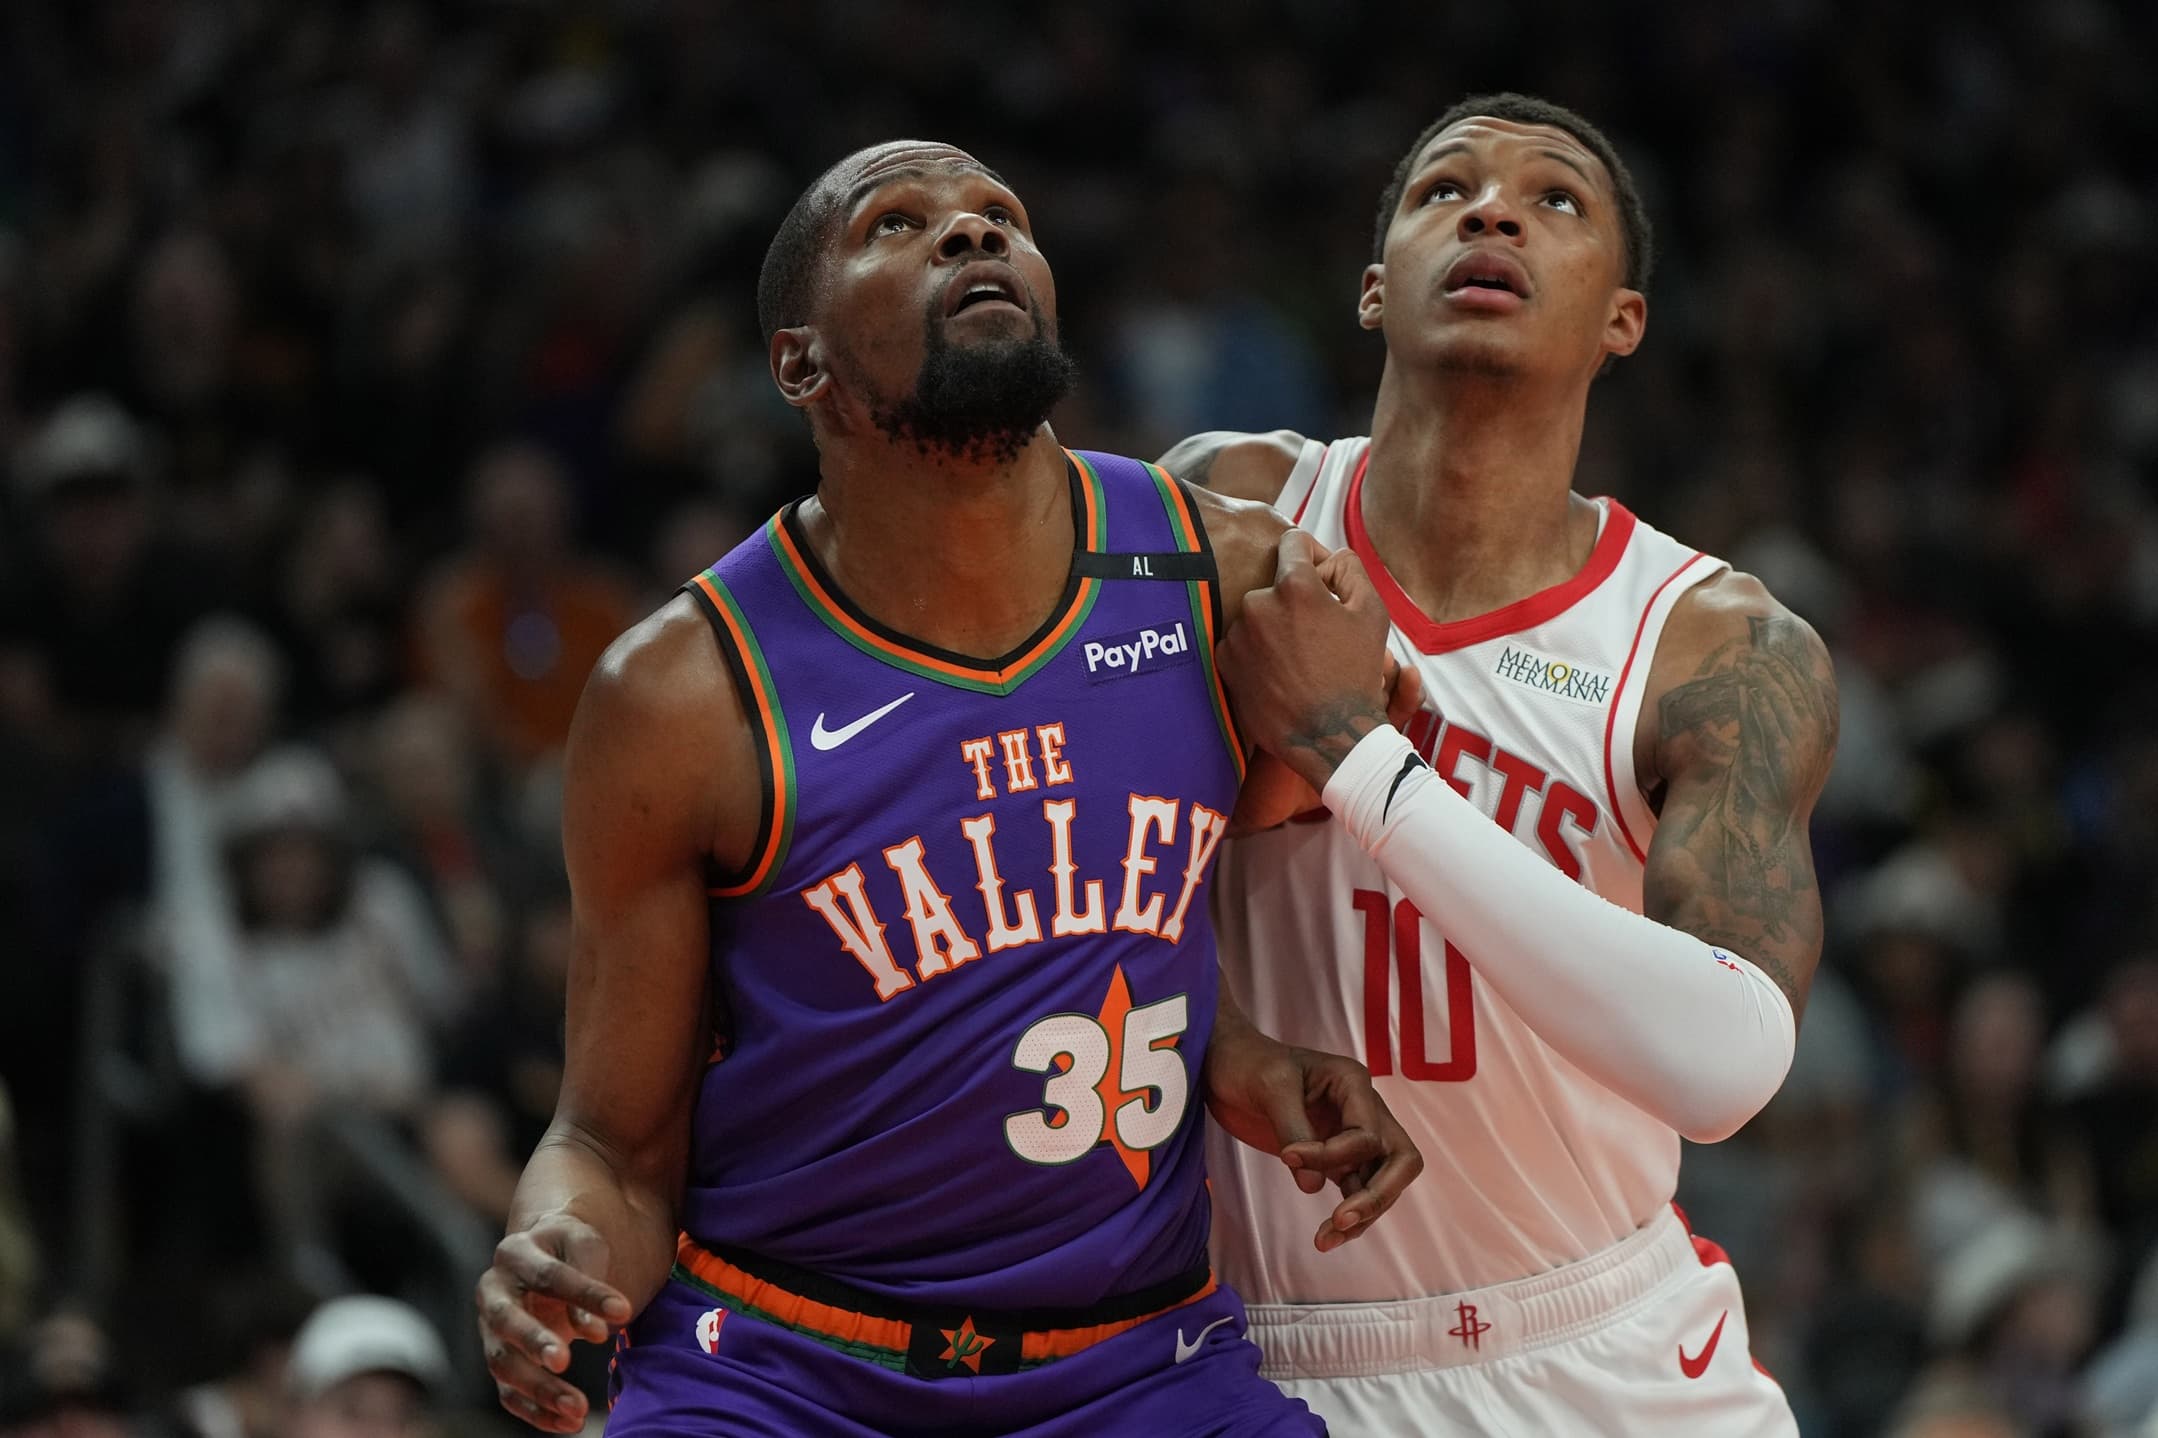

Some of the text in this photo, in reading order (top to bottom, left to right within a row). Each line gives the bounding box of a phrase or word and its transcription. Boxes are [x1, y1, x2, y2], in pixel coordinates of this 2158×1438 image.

[1132, 556, 1154, 576] AL
[1084, 622, 1188, 673] PayPal
[1501, 646, 1610, 691] MEMORIAL
[1496, 660, 1609, 703] HERMANN
[961, 721, 1074, 800] THE
[801, 792, 1229, 1002] VALLEY
[1352, 888, 1477, 1082] 10
[1003, 991, 1188, 1167] 35
